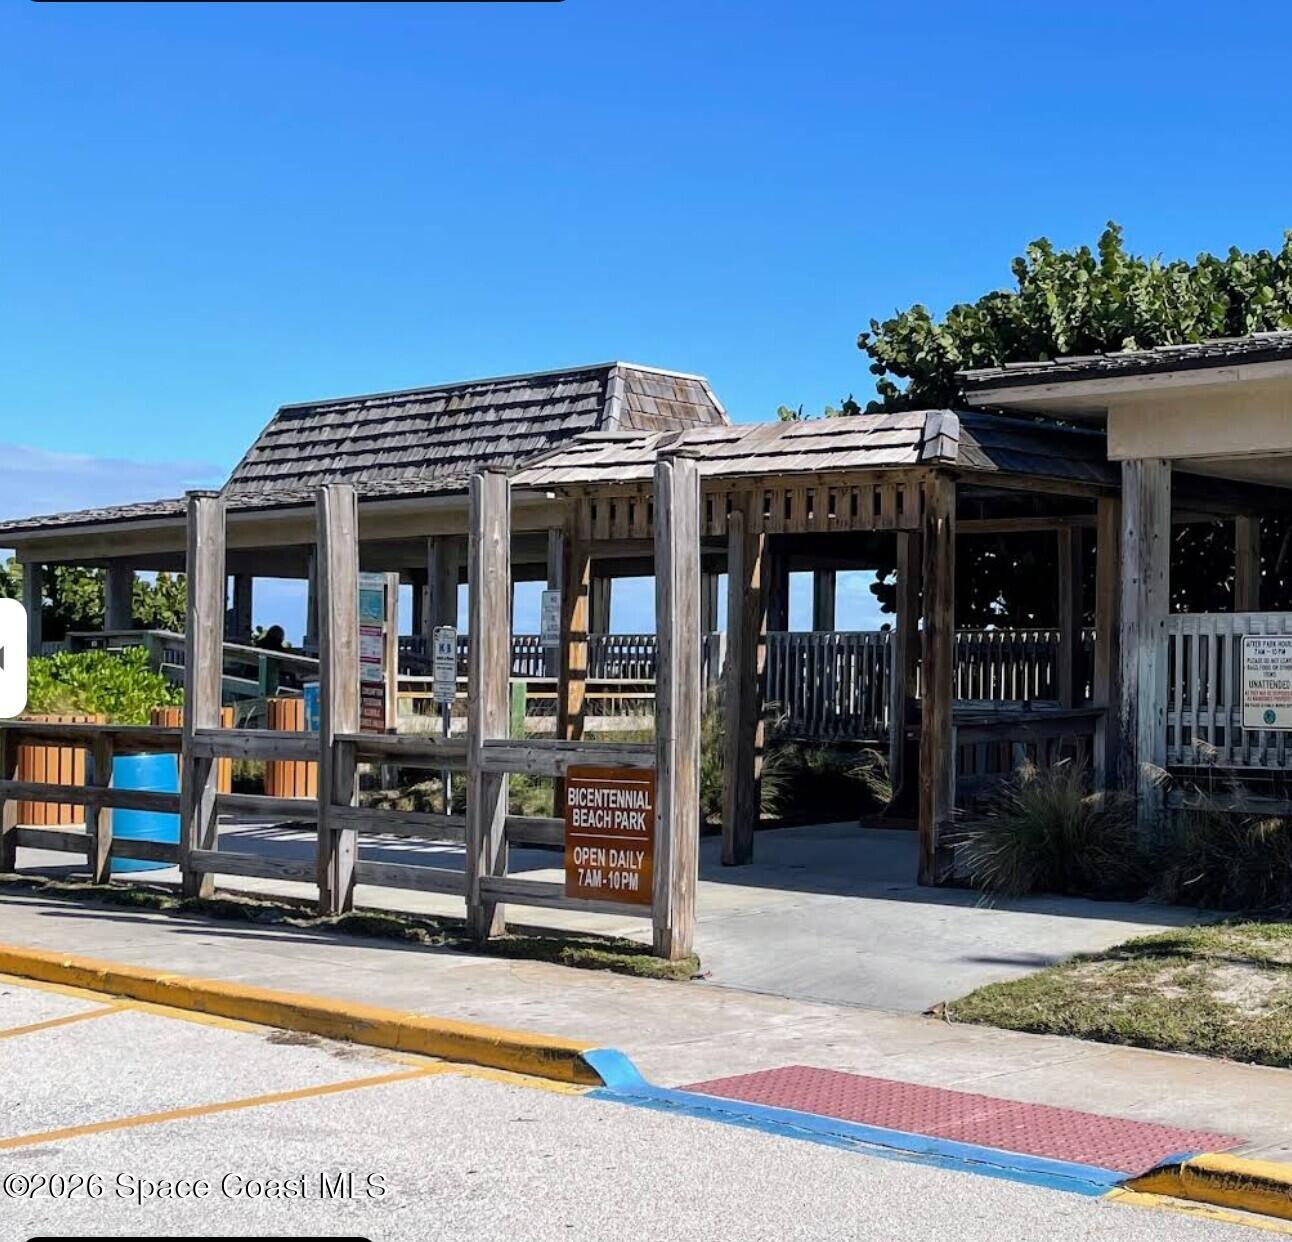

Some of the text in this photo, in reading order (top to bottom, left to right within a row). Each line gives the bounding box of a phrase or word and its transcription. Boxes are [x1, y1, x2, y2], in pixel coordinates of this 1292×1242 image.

[1262, 640, 1276, 648] PARK
[1249, 680, 1290, 689] UNATTENDED
[568, 788, 652, 810] BICENTENNIAL
[572, 809, 646, 831] BEACH PARK
[573, 847, 645, 869] OPEN DAILY
